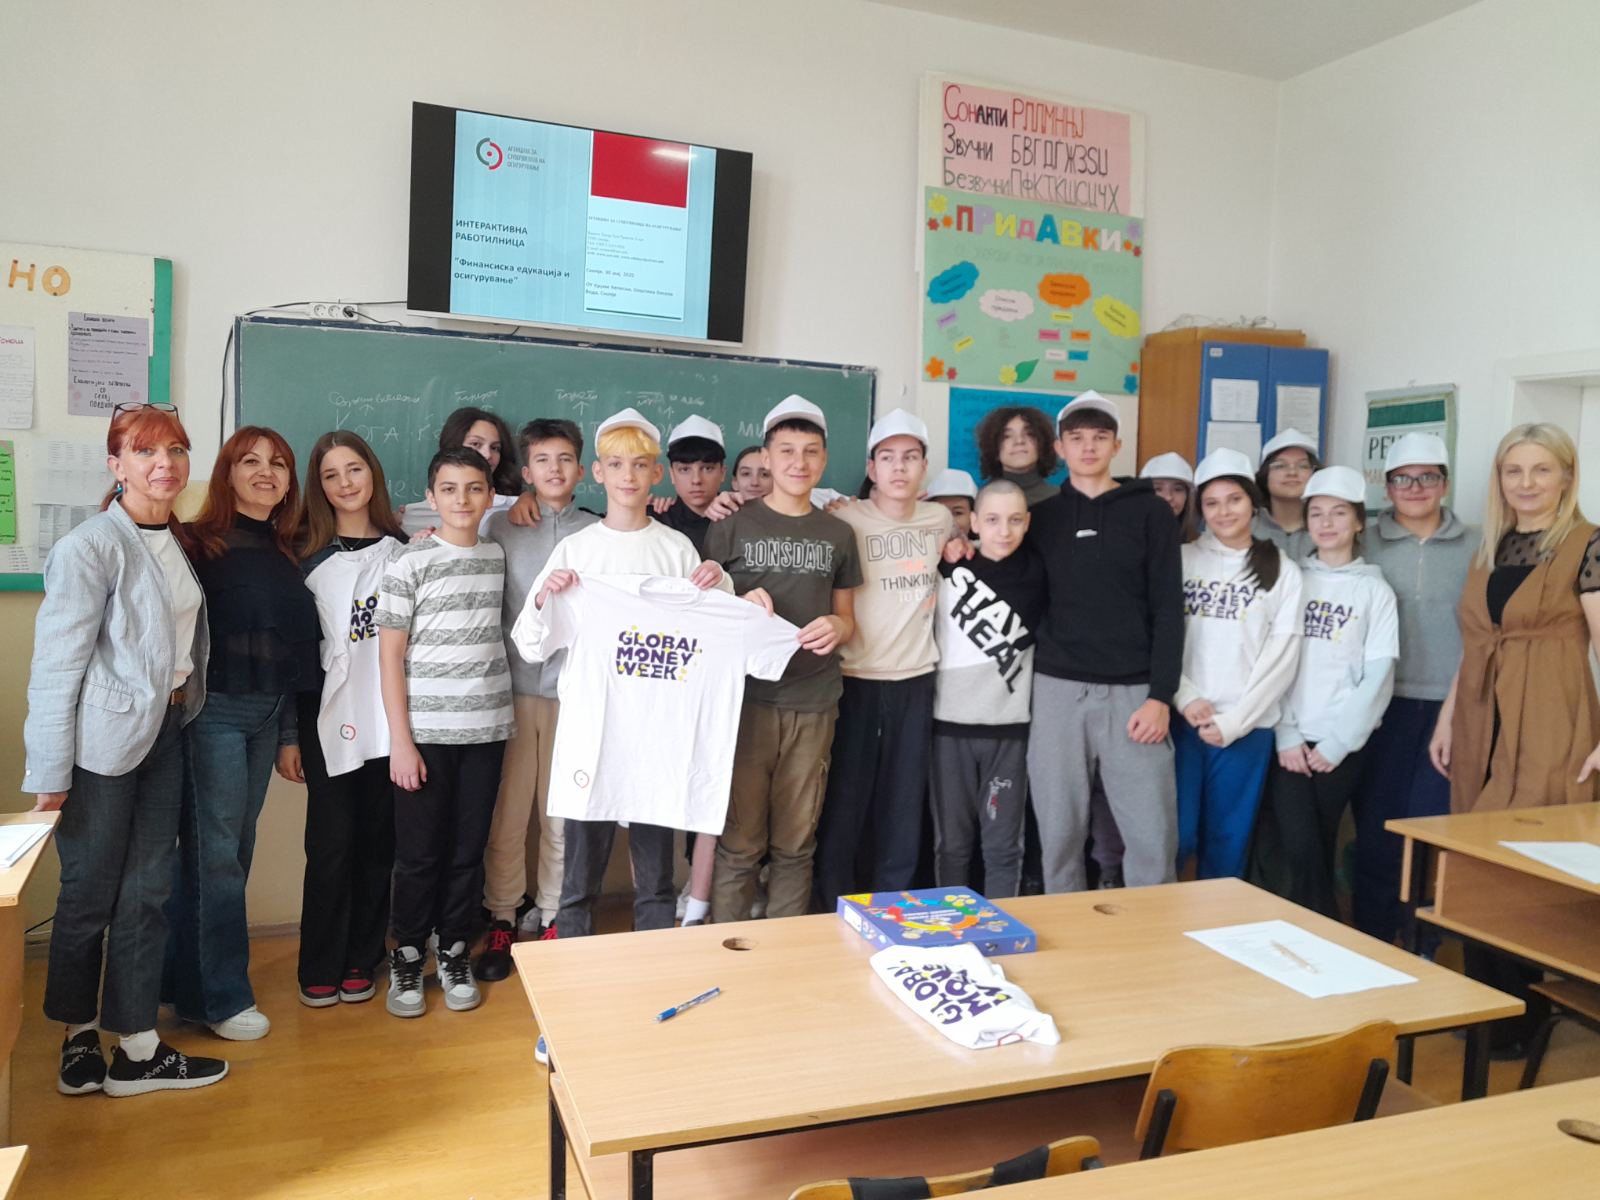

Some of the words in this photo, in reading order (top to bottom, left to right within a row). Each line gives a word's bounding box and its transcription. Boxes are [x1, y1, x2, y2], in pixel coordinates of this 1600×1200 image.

[944, 123, 993, 161] Звучни
[455, 219, 528, 235] ИНТЕРАКТИВНА
[455, 231, 525, 248] РАБОТИЛНИЦА
[956, 203, 1122, 253] ПРИДАВКИ
[517, 265, 562, 279] едукација
[745, 541, 834, 573] LONSDALE
[865, 528, 944, 562] DON'T
[950, 566, 1030, 646] STAY
[618, 630, 702, 653] GLOBAL
[950, 604, 1024, 694] REAL
[616, 647, 693, 667] MONEY
[616, 660, 677, 681] WEEK
